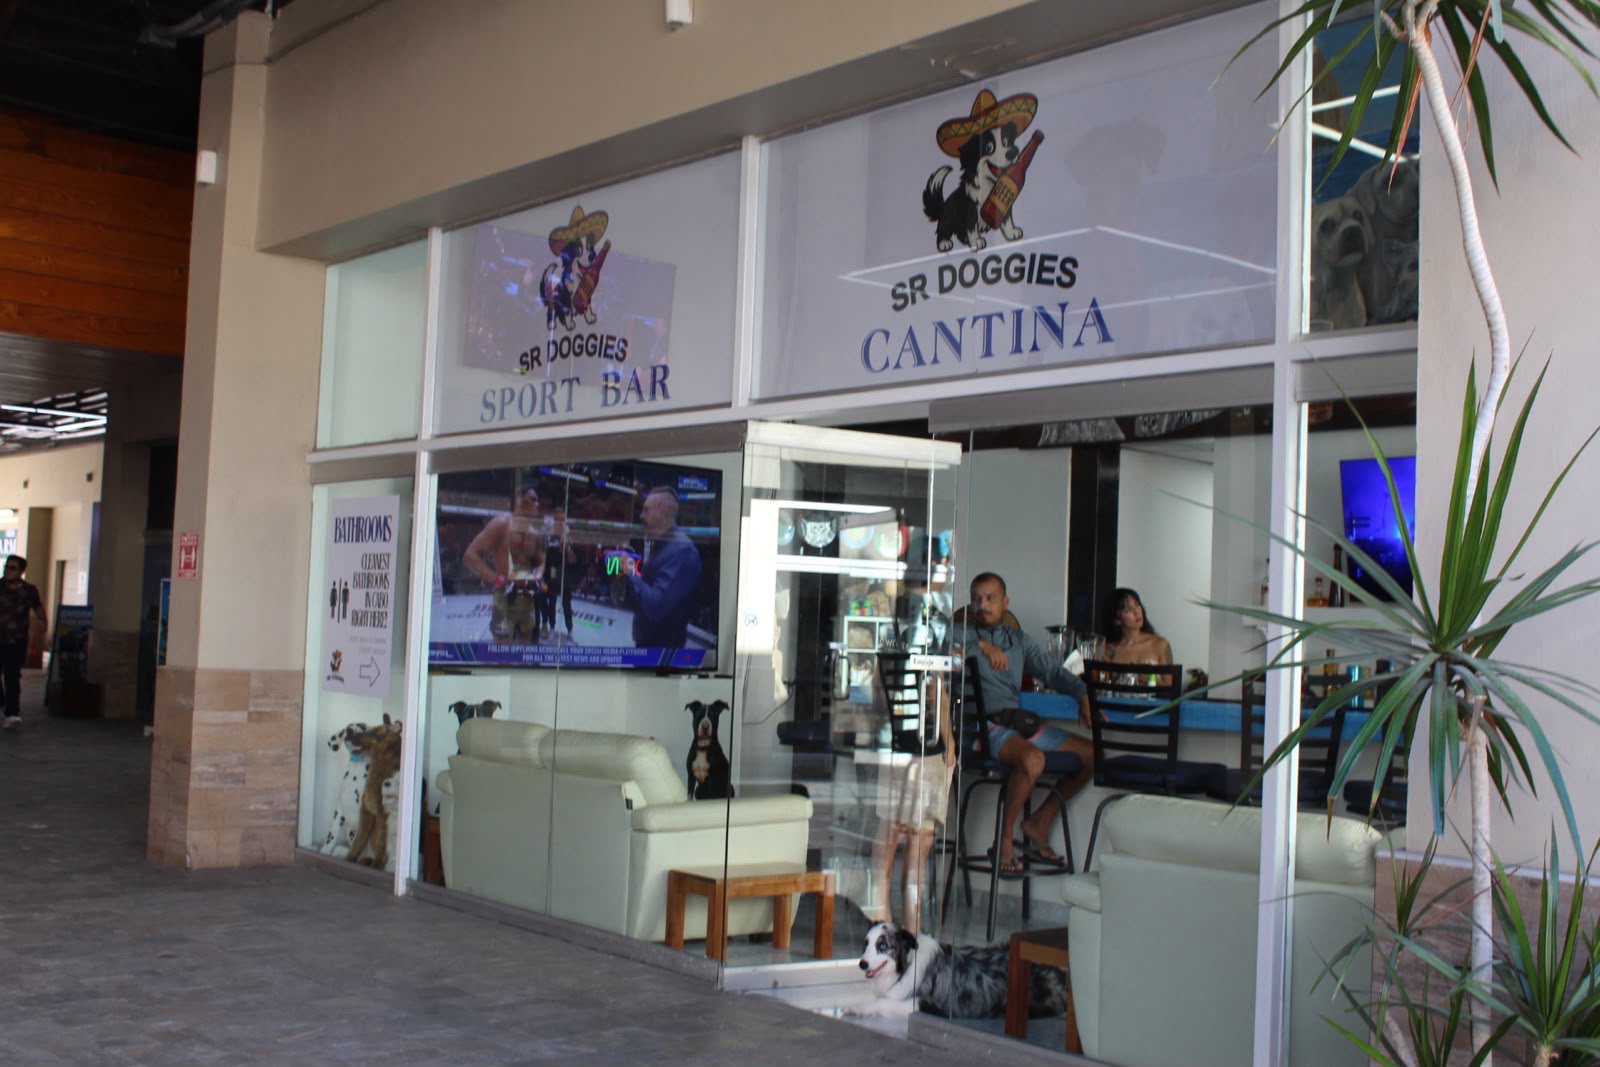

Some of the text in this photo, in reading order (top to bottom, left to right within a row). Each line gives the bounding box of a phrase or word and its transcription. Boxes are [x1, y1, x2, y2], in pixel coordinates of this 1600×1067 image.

[992, 178, 1016, 209] BEER
[890, 252, 1079, 312] SR DOGGIES
[860, 296, 1114, 374] CANTINA
[518, 333, 628, 375] SR DOGGIES
[480, 364, 672, 424] SPORT BAR
[333, 514, 393, 545] BATHROOMS
[361, 552, 391, 571] CLEANEST
[352, 571, 390, 590] BATHROOMS
[364, 591, 389, 609] IN CABO
[351, 609, 369, 627] RIGHT
